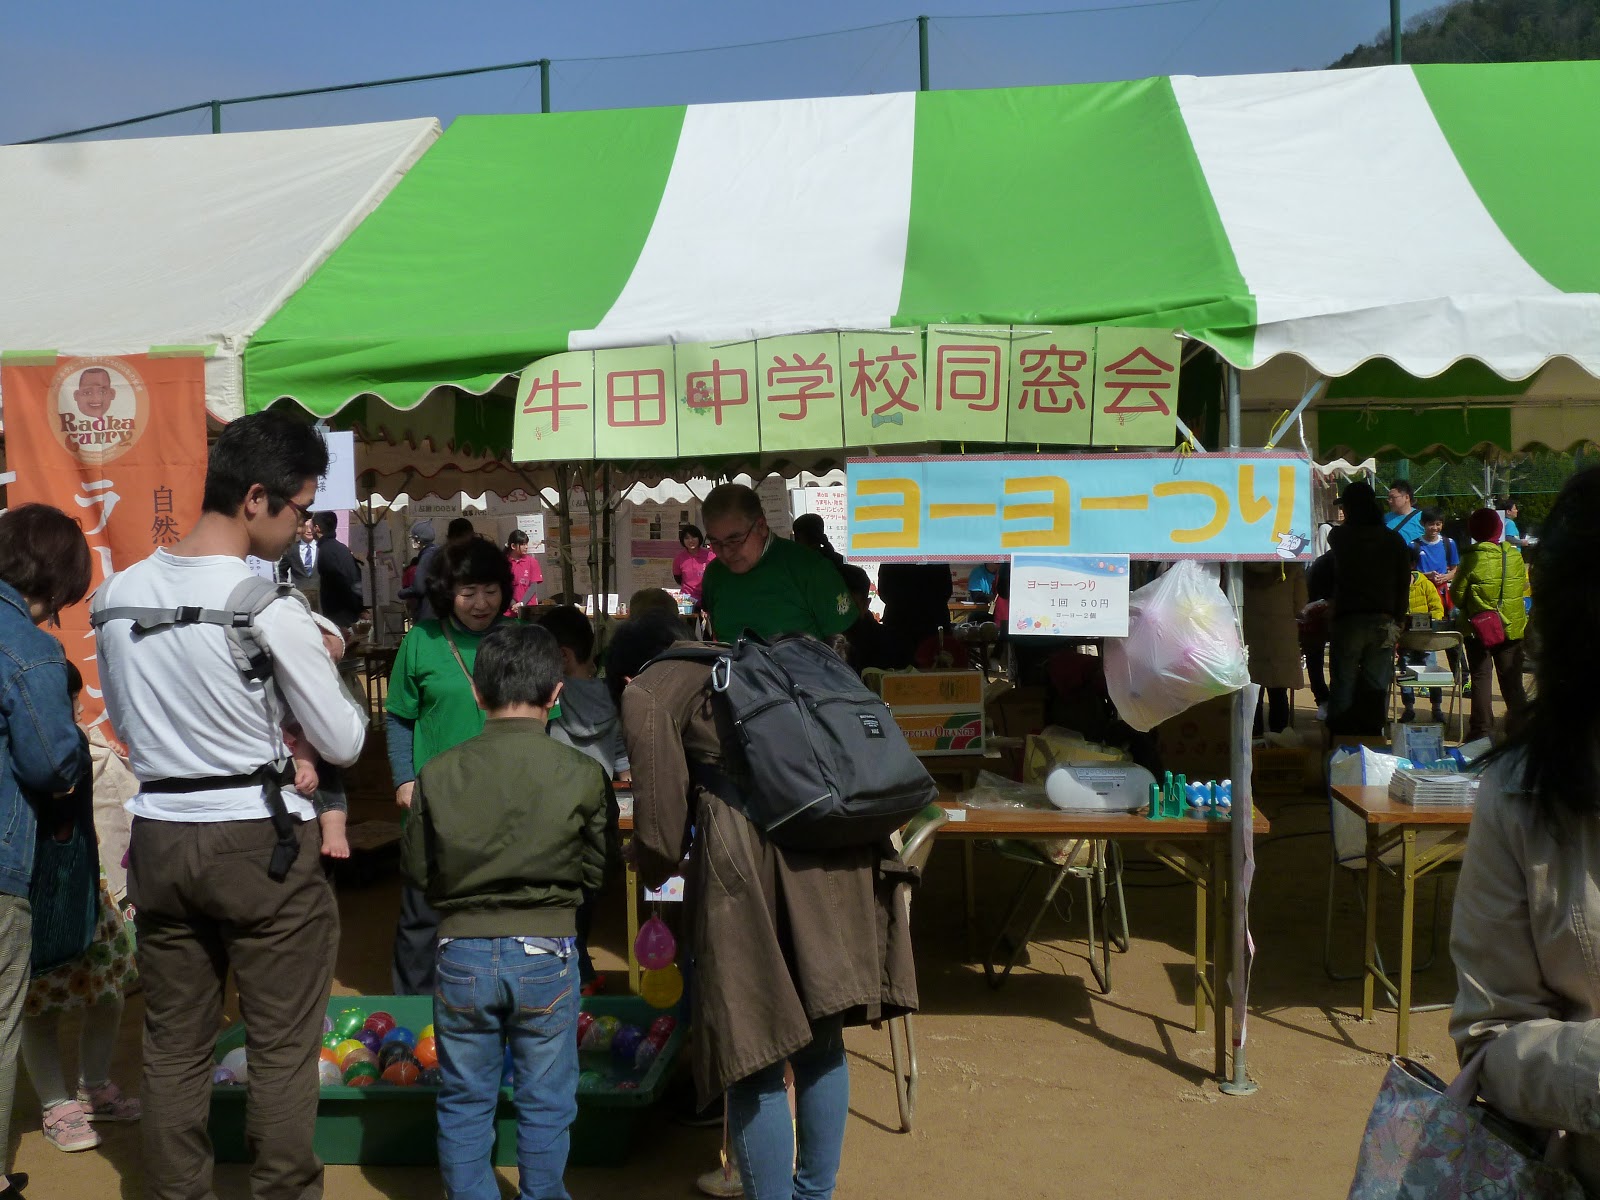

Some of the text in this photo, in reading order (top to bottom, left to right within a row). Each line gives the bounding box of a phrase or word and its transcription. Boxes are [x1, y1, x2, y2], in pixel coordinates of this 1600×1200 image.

[522, 344, 1176, 433] 牛田中学校同窓会
[59, 412, 136, 432] Radha
[150, 485, 181, 544] 自然
[851, 464, 1297, 549] ヨーヨーつり
[1027, 579, 1096, 592] ヨーヨーつり
[1050, 598, 1109, 609] 1回 50円
